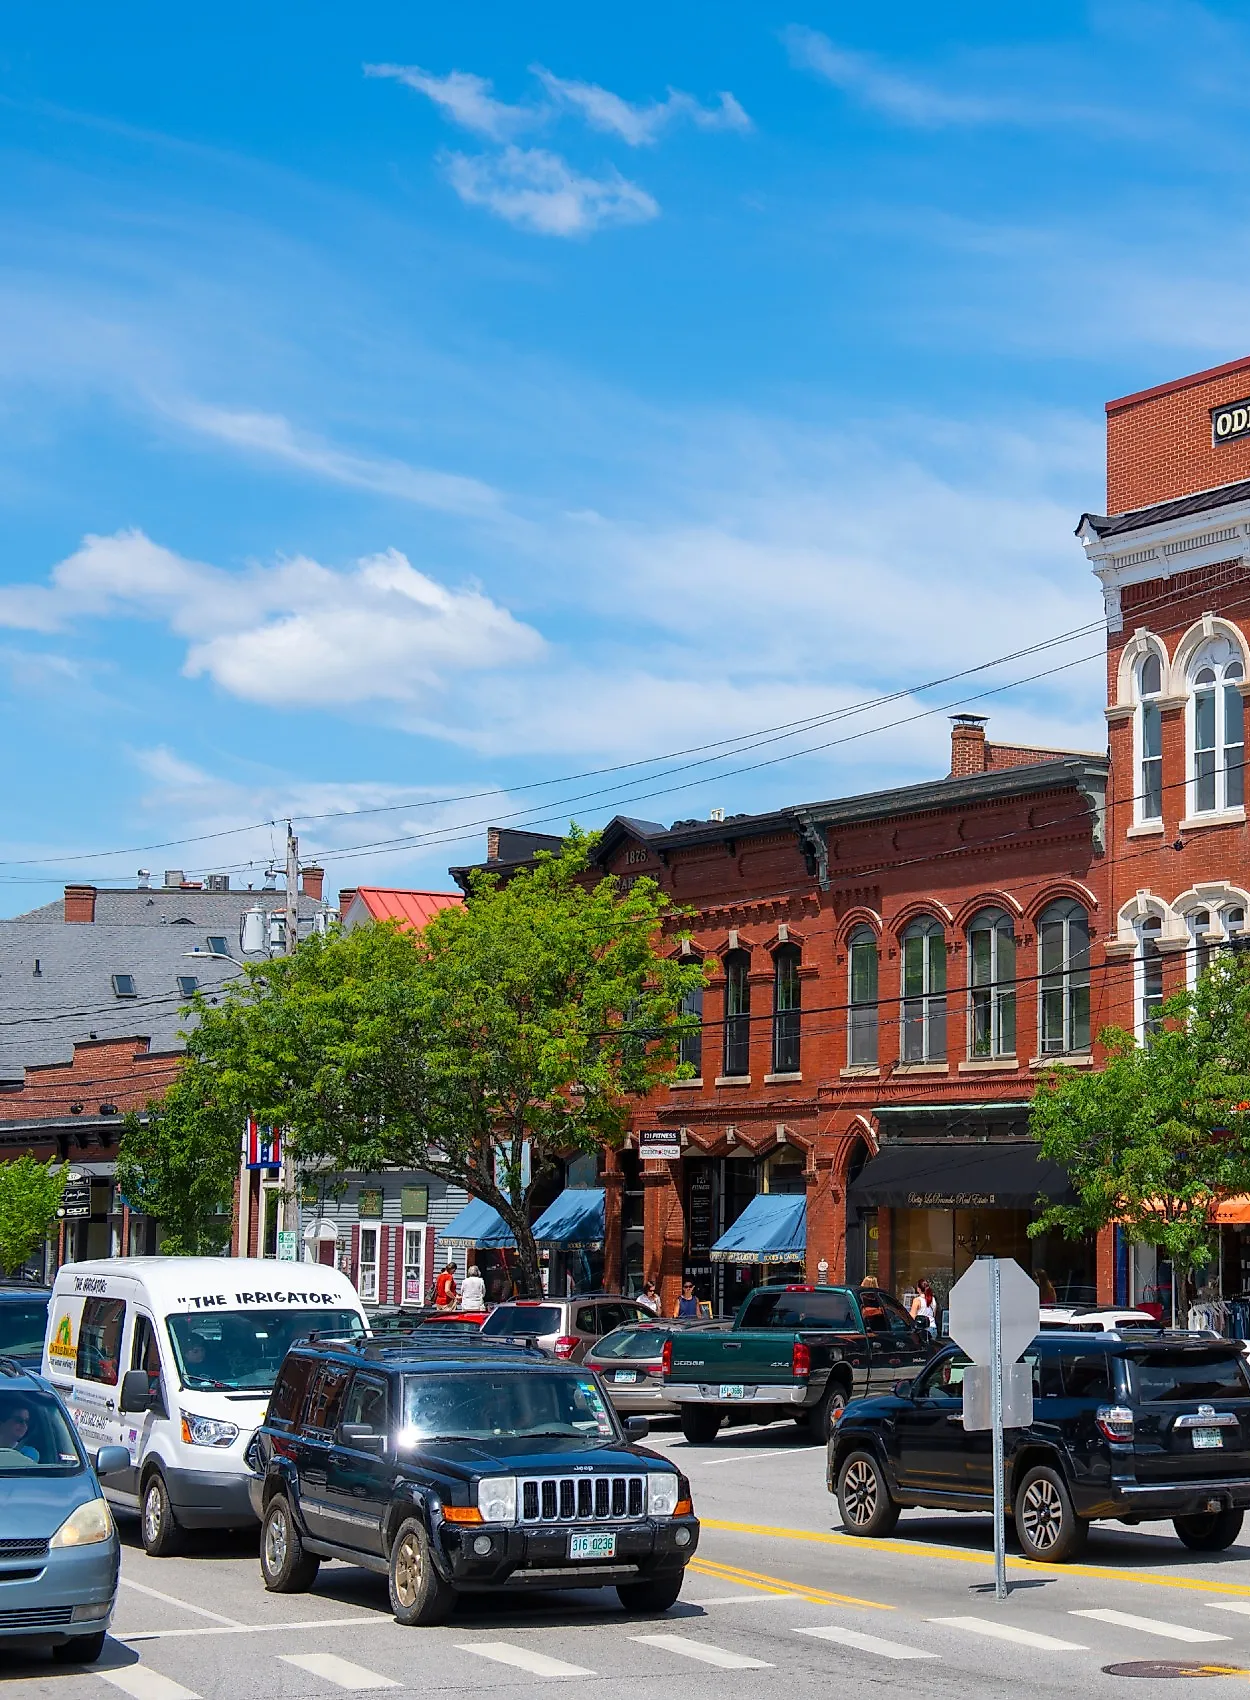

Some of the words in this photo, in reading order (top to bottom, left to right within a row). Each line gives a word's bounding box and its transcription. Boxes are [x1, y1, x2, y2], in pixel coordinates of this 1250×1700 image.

[236, 1291, 342, 1305] IRRIGATOR"
[572, 1538, 588, 1551] 316
[592, 1537, 613, 1550] 0236
